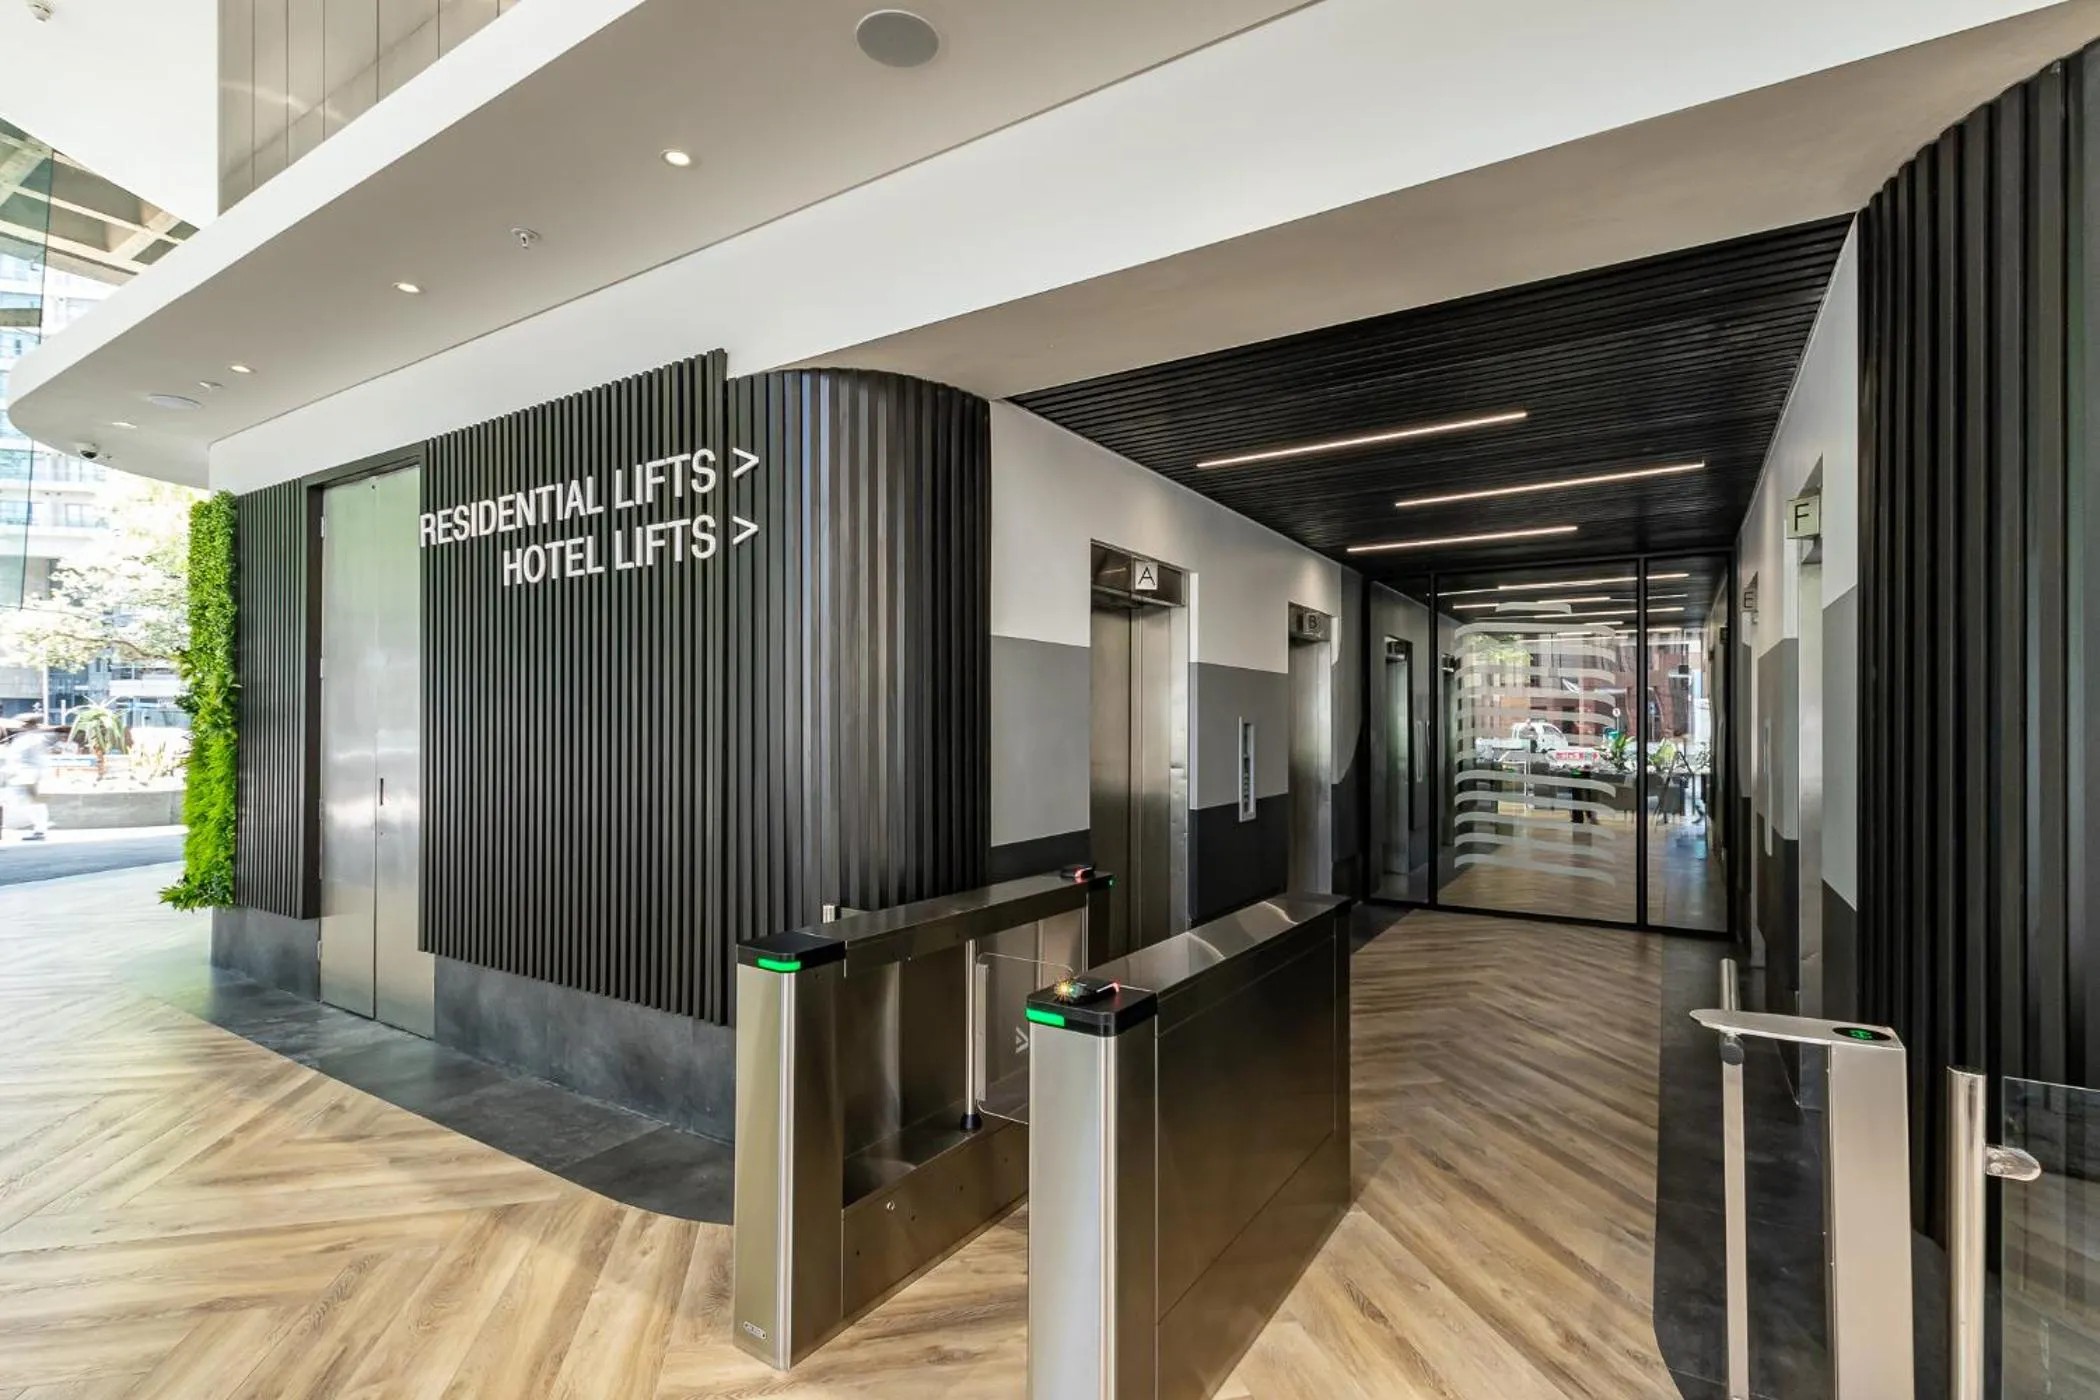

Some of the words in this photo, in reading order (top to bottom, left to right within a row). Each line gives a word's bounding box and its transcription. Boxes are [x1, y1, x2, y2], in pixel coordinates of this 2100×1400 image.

[420, 475, 604, 547] RESIDENTIAL
[615, 448, 716, 509] LIFTS
[1794, 503, 1809, 531] F
[503, 535, 605, 586] HOTEL
[615, 515, 716, 570] LIFTS
[1137, 566, 1156, 586] A
[1743, 591, 1753, 608] E
